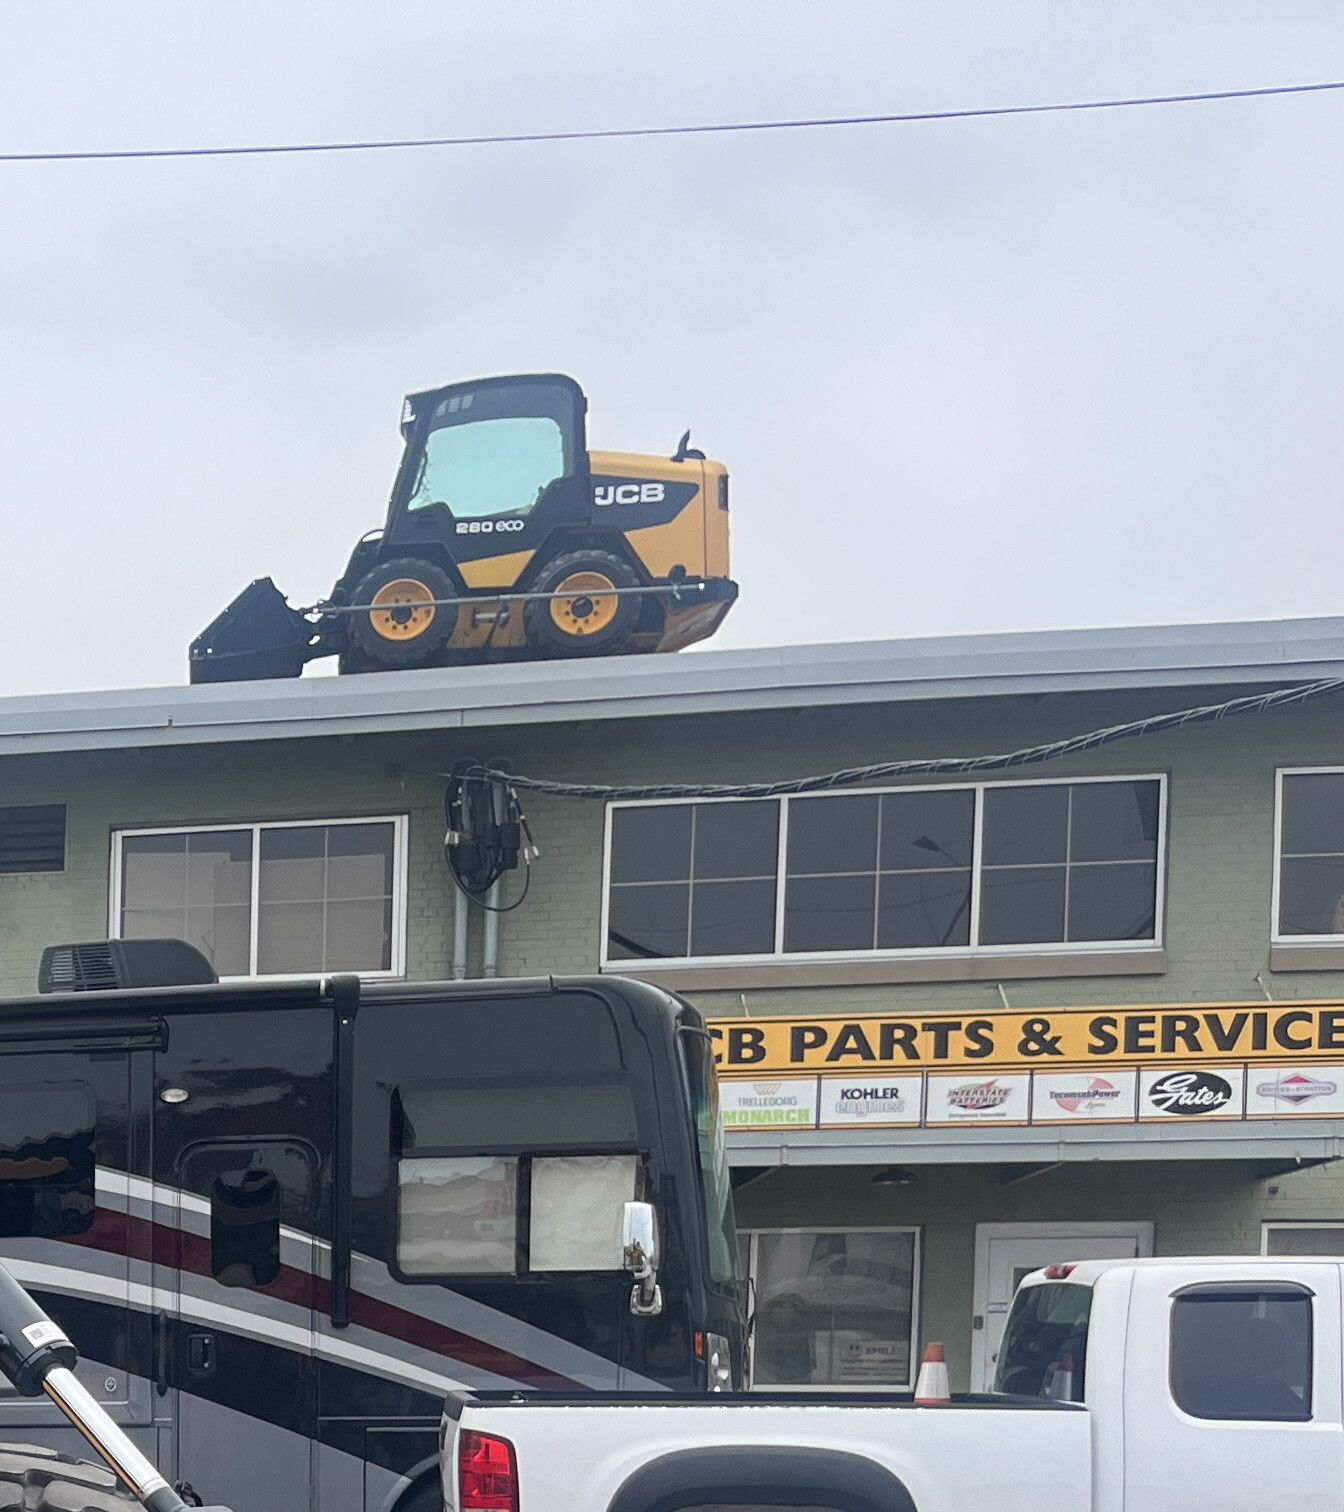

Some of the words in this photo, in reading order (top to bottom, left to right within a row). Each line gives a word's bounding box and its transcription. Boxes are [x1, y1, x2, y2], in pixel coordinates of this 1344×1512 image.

[595, 483, 665, 506] JCB
[790, 1019, 995, 1062] PARTS
[1016, 1018, 1065, 1056] &
[1088, 1010, 1344, 1054] SERVICE
[840, 1088, 899, 1100] KOHLER
[947, 1088, 1011, 1097] INTERSTATE
[1150, 1073, 1227, 1110] Gates
[723, 1108, 810, 1124] MONARCH
[835, 1100, 905, 1117] engines
